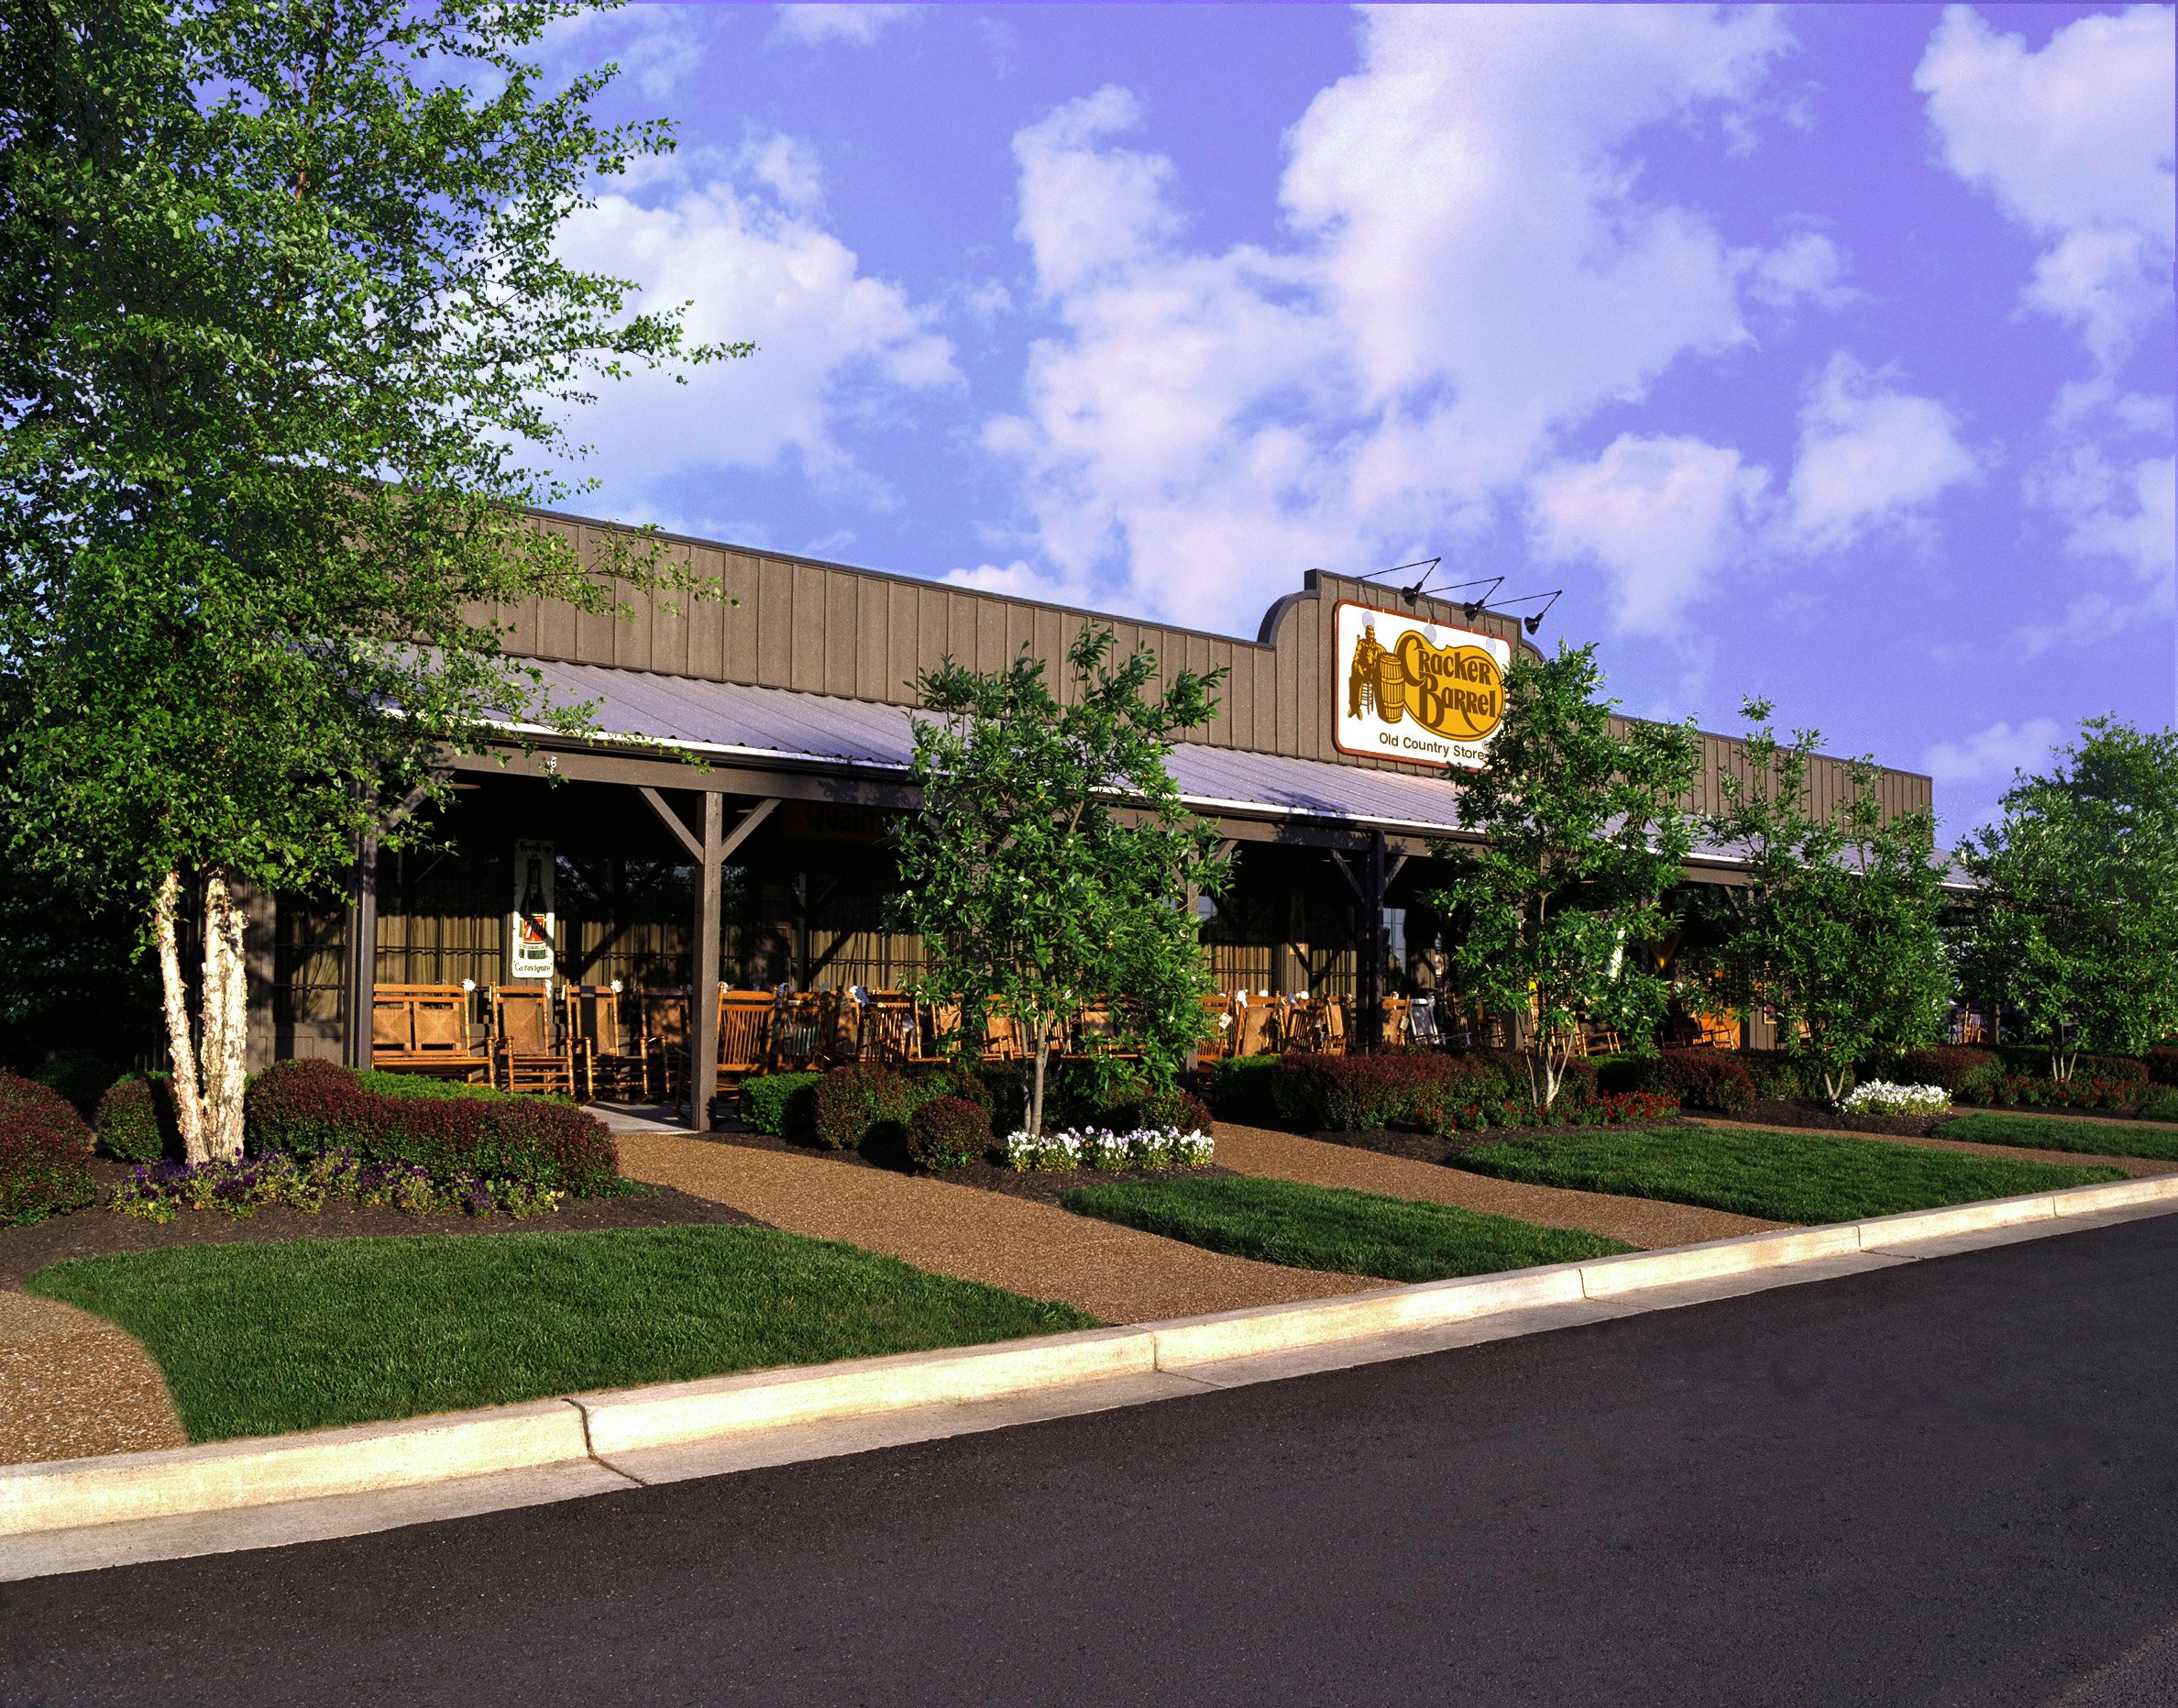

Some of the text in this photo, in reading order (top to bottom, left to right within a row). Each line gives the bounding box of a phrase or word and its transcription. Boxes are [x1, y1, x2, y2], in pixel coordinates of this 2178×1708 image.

[1395, 634, 1492, 688] Cracker
[1418, 670, 1497, 733] Barrel
[1379, 732, 1485, 761] Old Country Store
